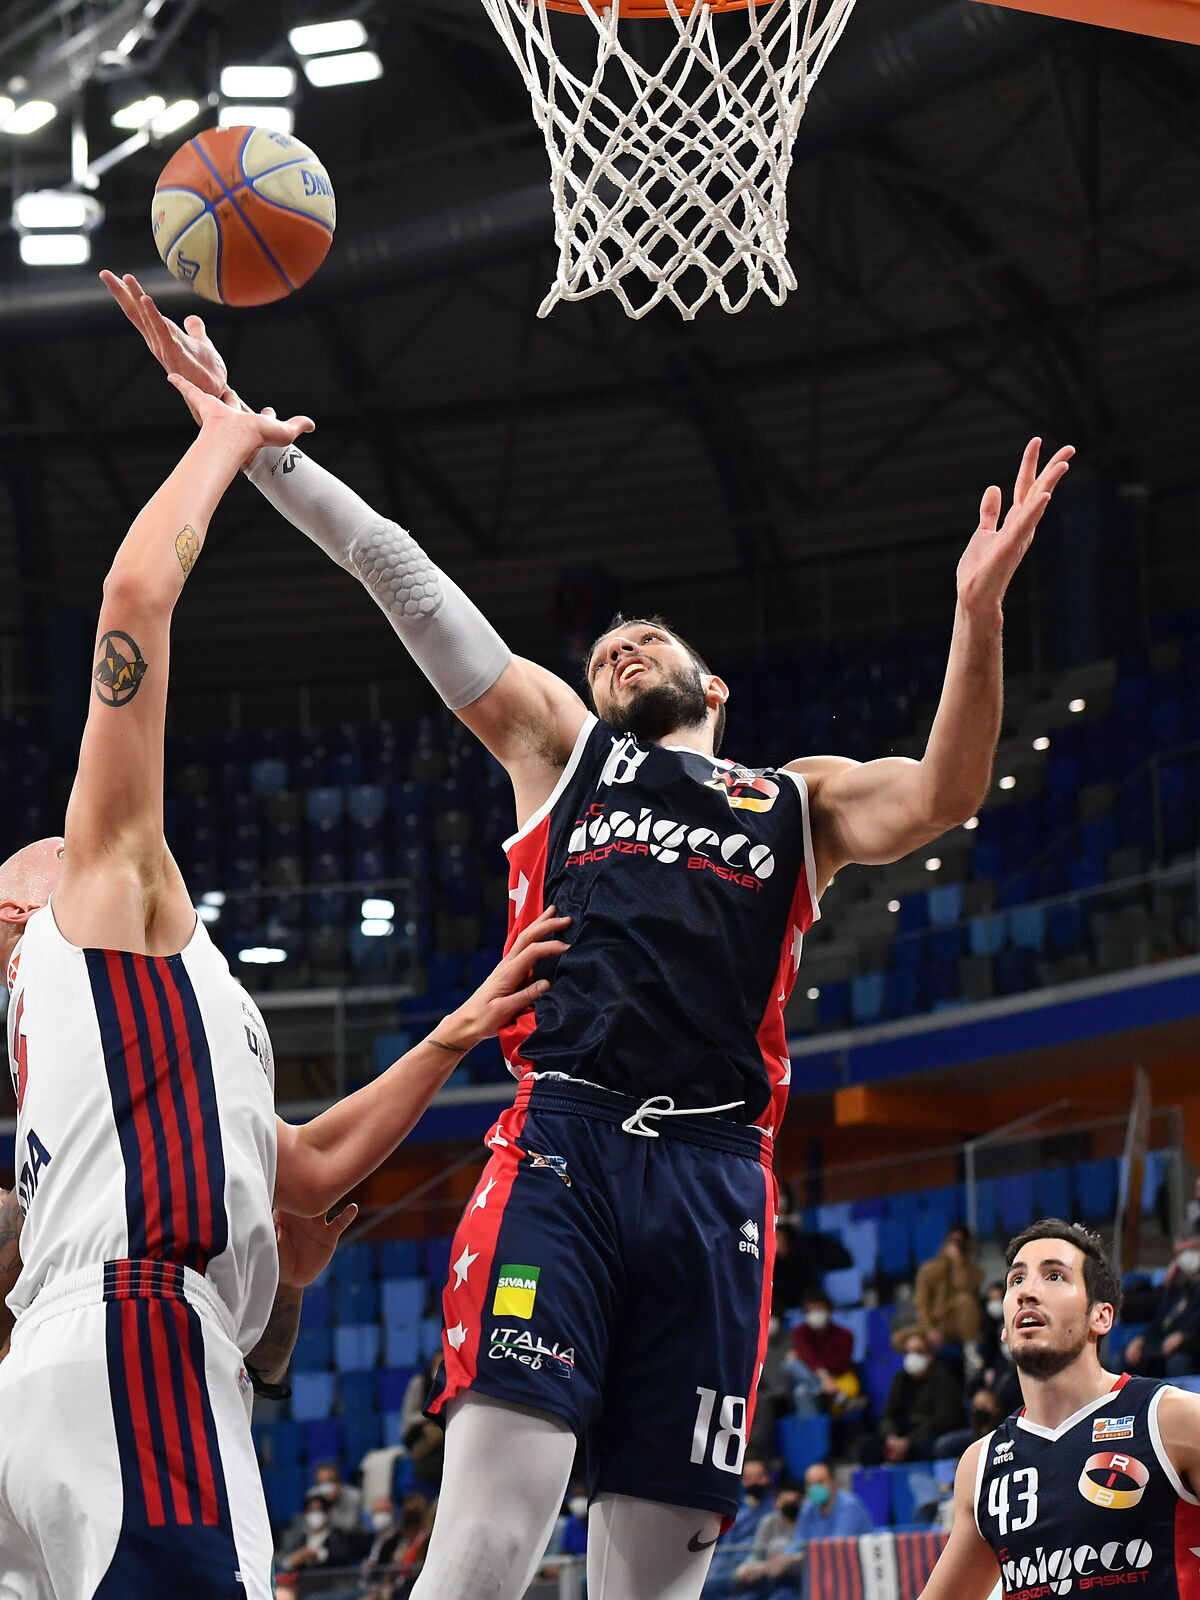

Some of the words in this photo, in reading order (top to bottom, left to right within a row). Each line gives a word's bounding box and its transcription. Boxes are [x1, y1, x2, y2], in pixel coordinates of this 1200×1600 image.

[687, 856, 765, 893] BASKET
[498, 1277, 537, 1290] SIVAM
[488, 1344, 543, 1371] Chef
[490, 1328, 576, 1364] ITALIA
[690, 1386, 746, 1475] 18
[1108, 1417, 1133, 1426] LNP
[988, 1467, 1039, 1536] 43
[1079, 1570, 1149, 1590] BASKET
